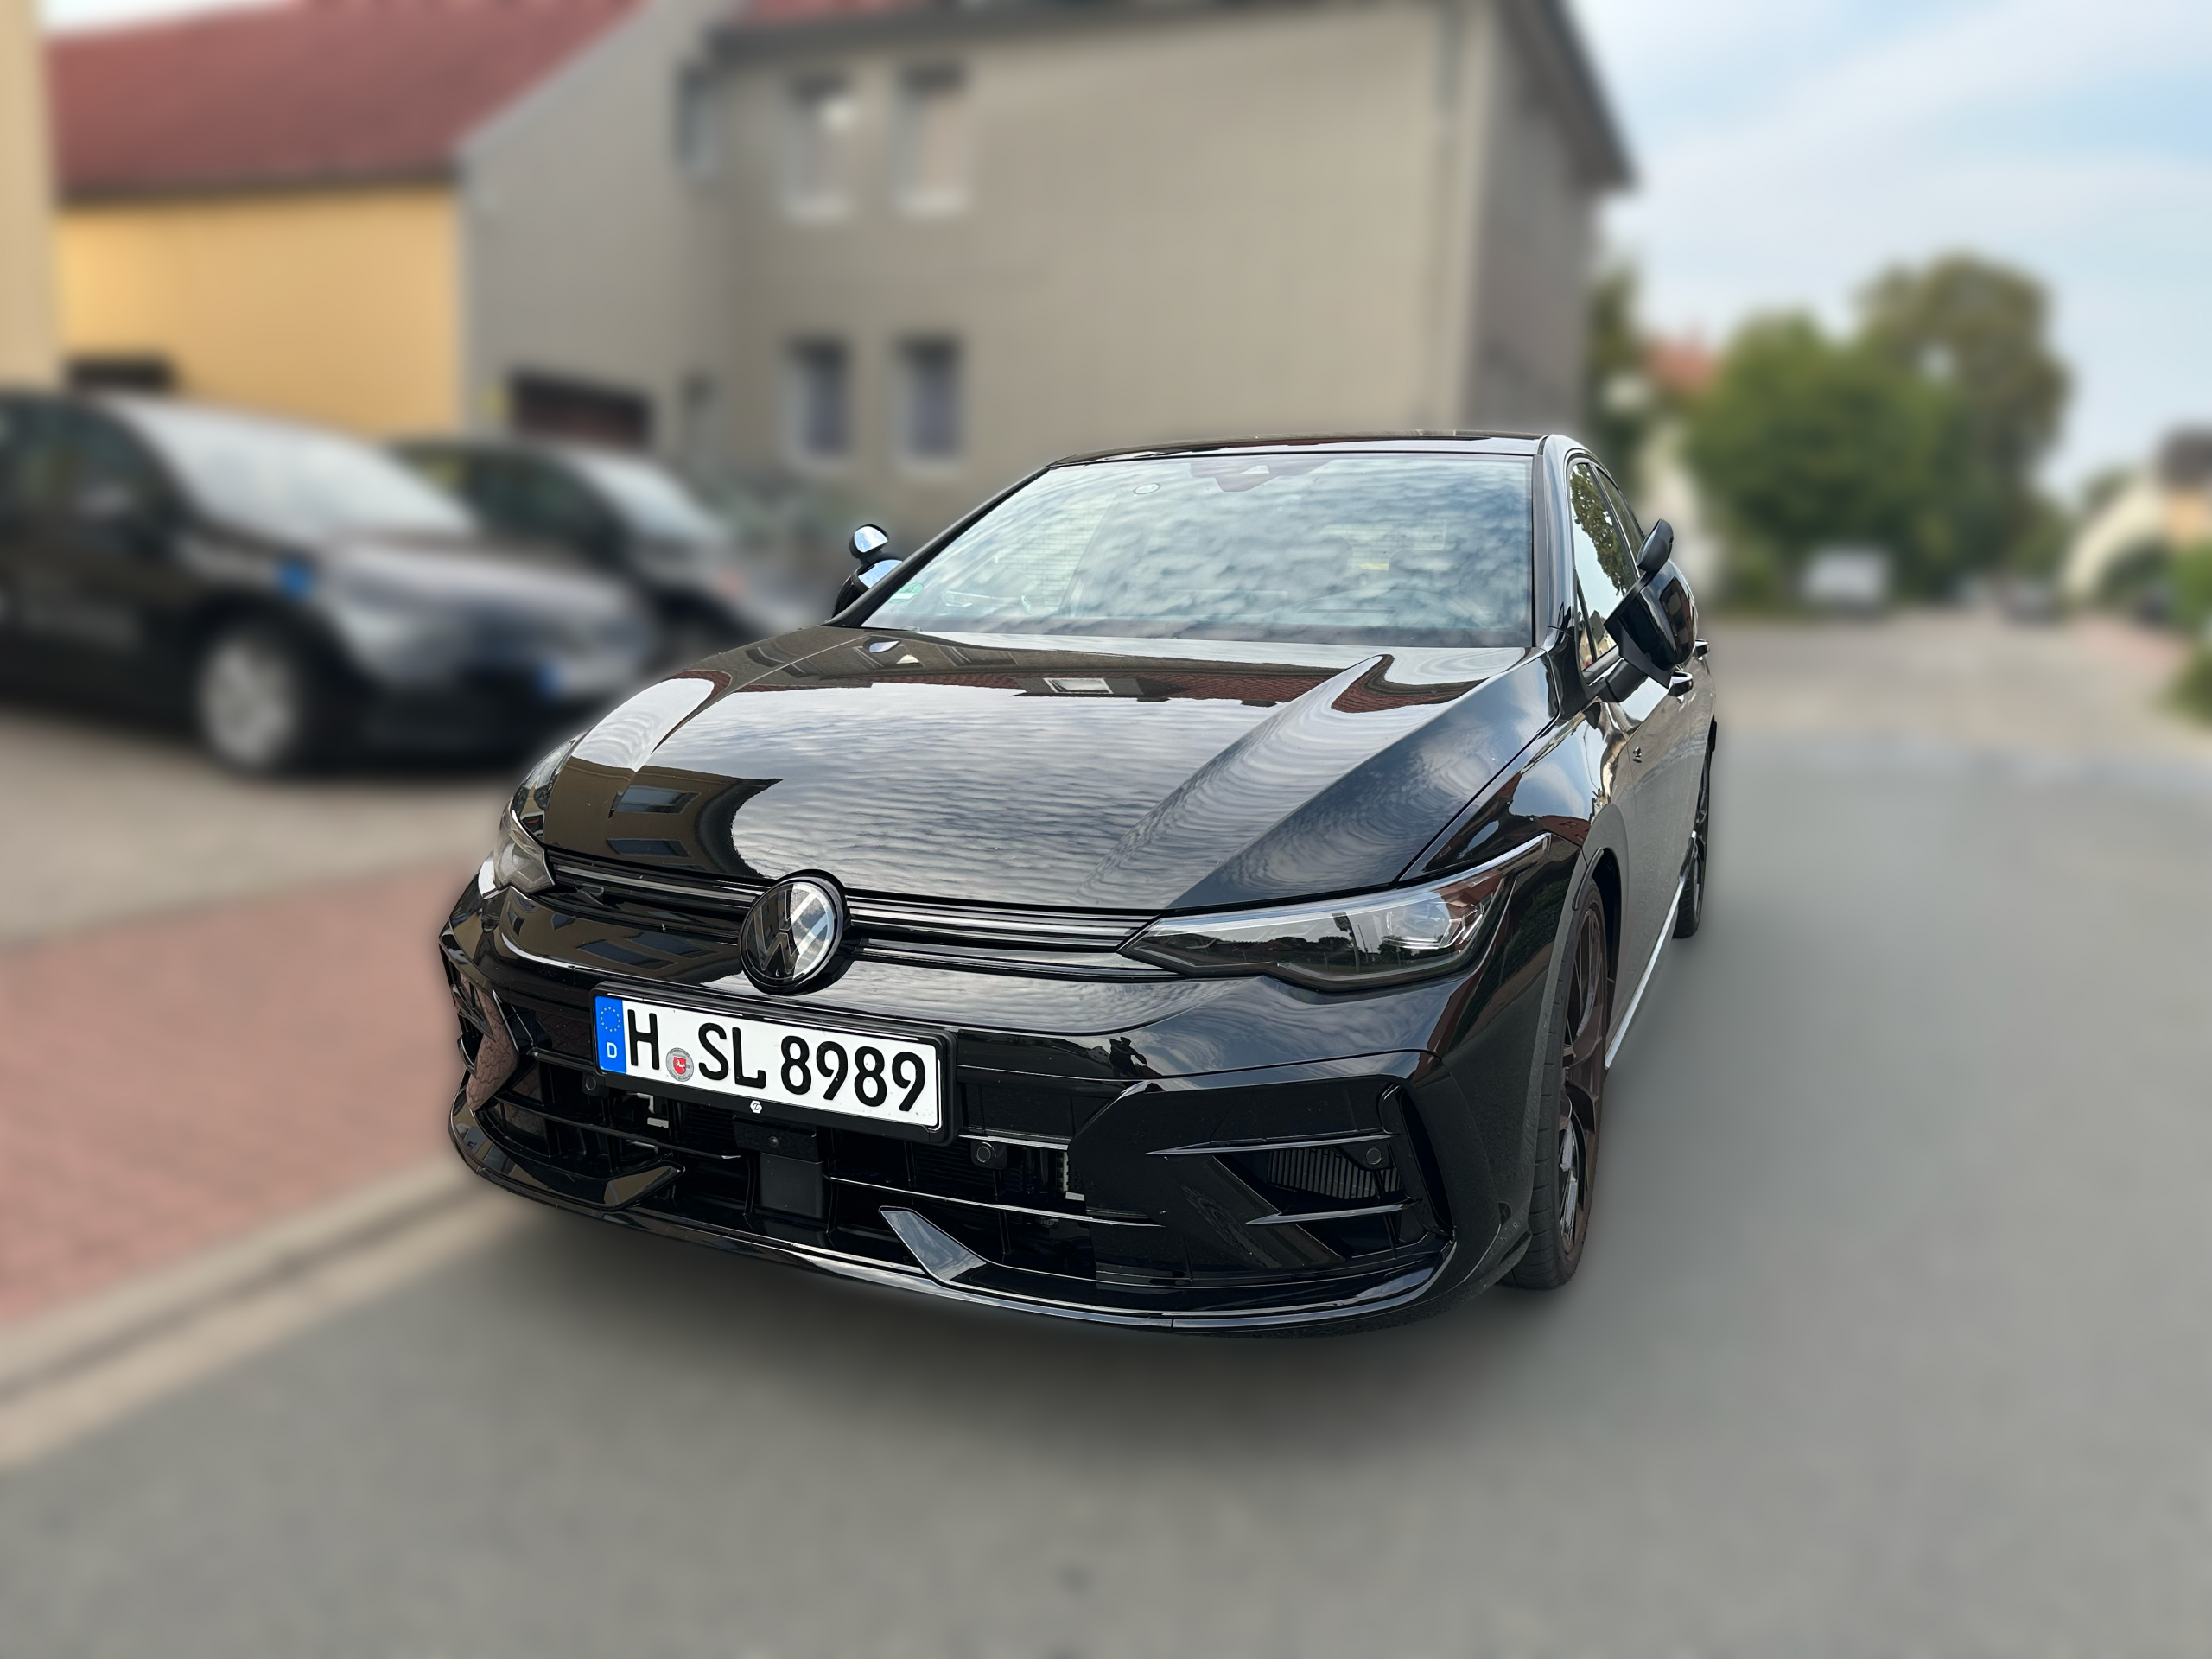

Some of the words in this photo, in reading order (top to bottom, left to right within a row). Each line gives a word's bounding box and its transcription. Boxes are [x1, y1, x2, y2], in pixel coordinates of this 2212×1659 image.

[607, 1041, 618, 1058] D
[627, 1008, 660, 1071] H
[697, 1022, 767, 1090] SL
[780, 1035, 926, 1112] 8989
